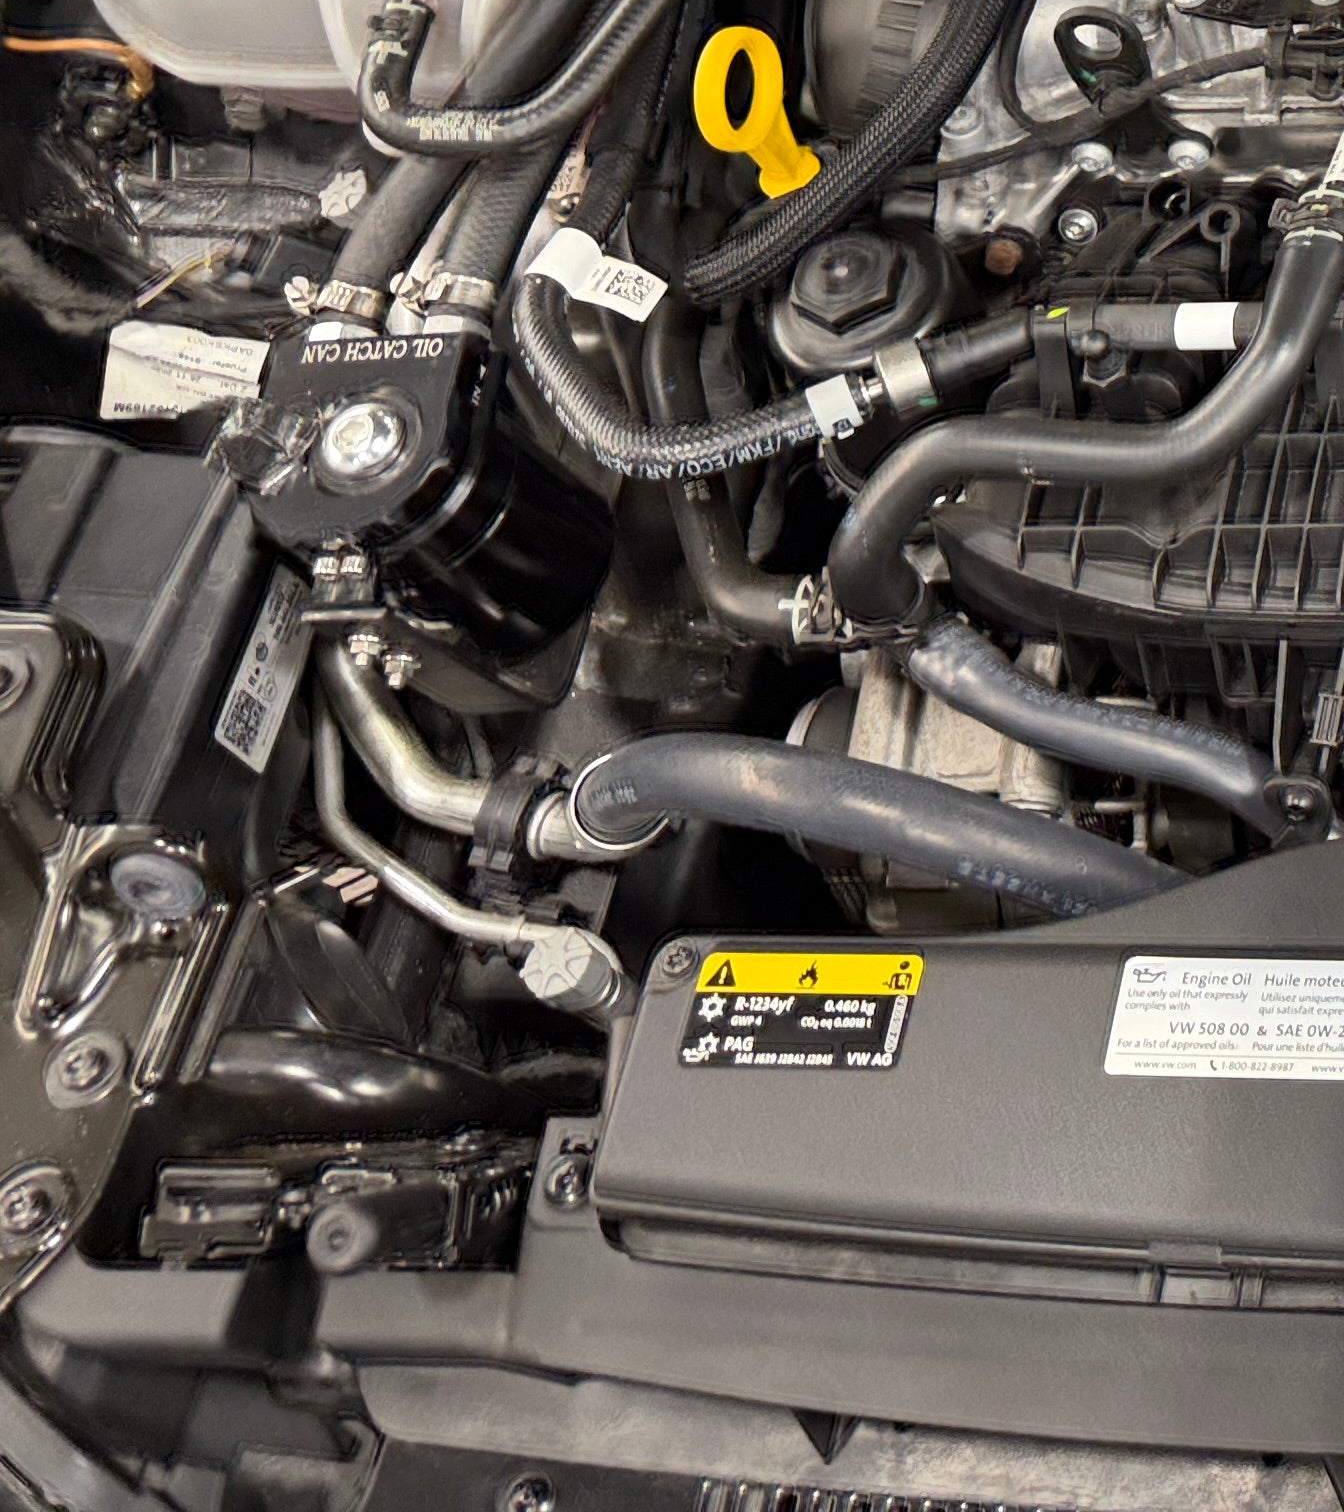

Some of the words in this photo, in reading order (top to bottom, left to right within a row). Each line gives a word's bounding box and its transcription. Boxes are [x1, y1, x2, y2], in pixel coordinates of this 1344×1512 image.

[301, 342, 341, 364] CAN
[344, 340, 408, 361] CATCH
[411, 338, 443, 358] OIL
[1182, 972, 1228, 988] Engine
[1232, 973, 1251, 985] Oil
[1265, 974, 1300, 986] Huile
[734, 996, 795, 1015] R-1234yf
[824, 1000, 858, 1013] 0.460
[860, 1000, 876, 1016] kg
[1170, 1022, 1195, 1034] VW
[1199, 1023, 1225, 1035] 508
[1230, 1023, 1249, 1035] 00
[1257, 1026, 1267, 1036] &
[1276, 1024, 1303, 1037] SAE
[723, 1036, 754, 1051] PAG
[735, 1053, 752, 1064] SAE
[847, 1052, 871, 1065] VW
[870, 1053, 893, 1066] AG
[1222, 1062, 1294, 1071] 1-800-822-8987
